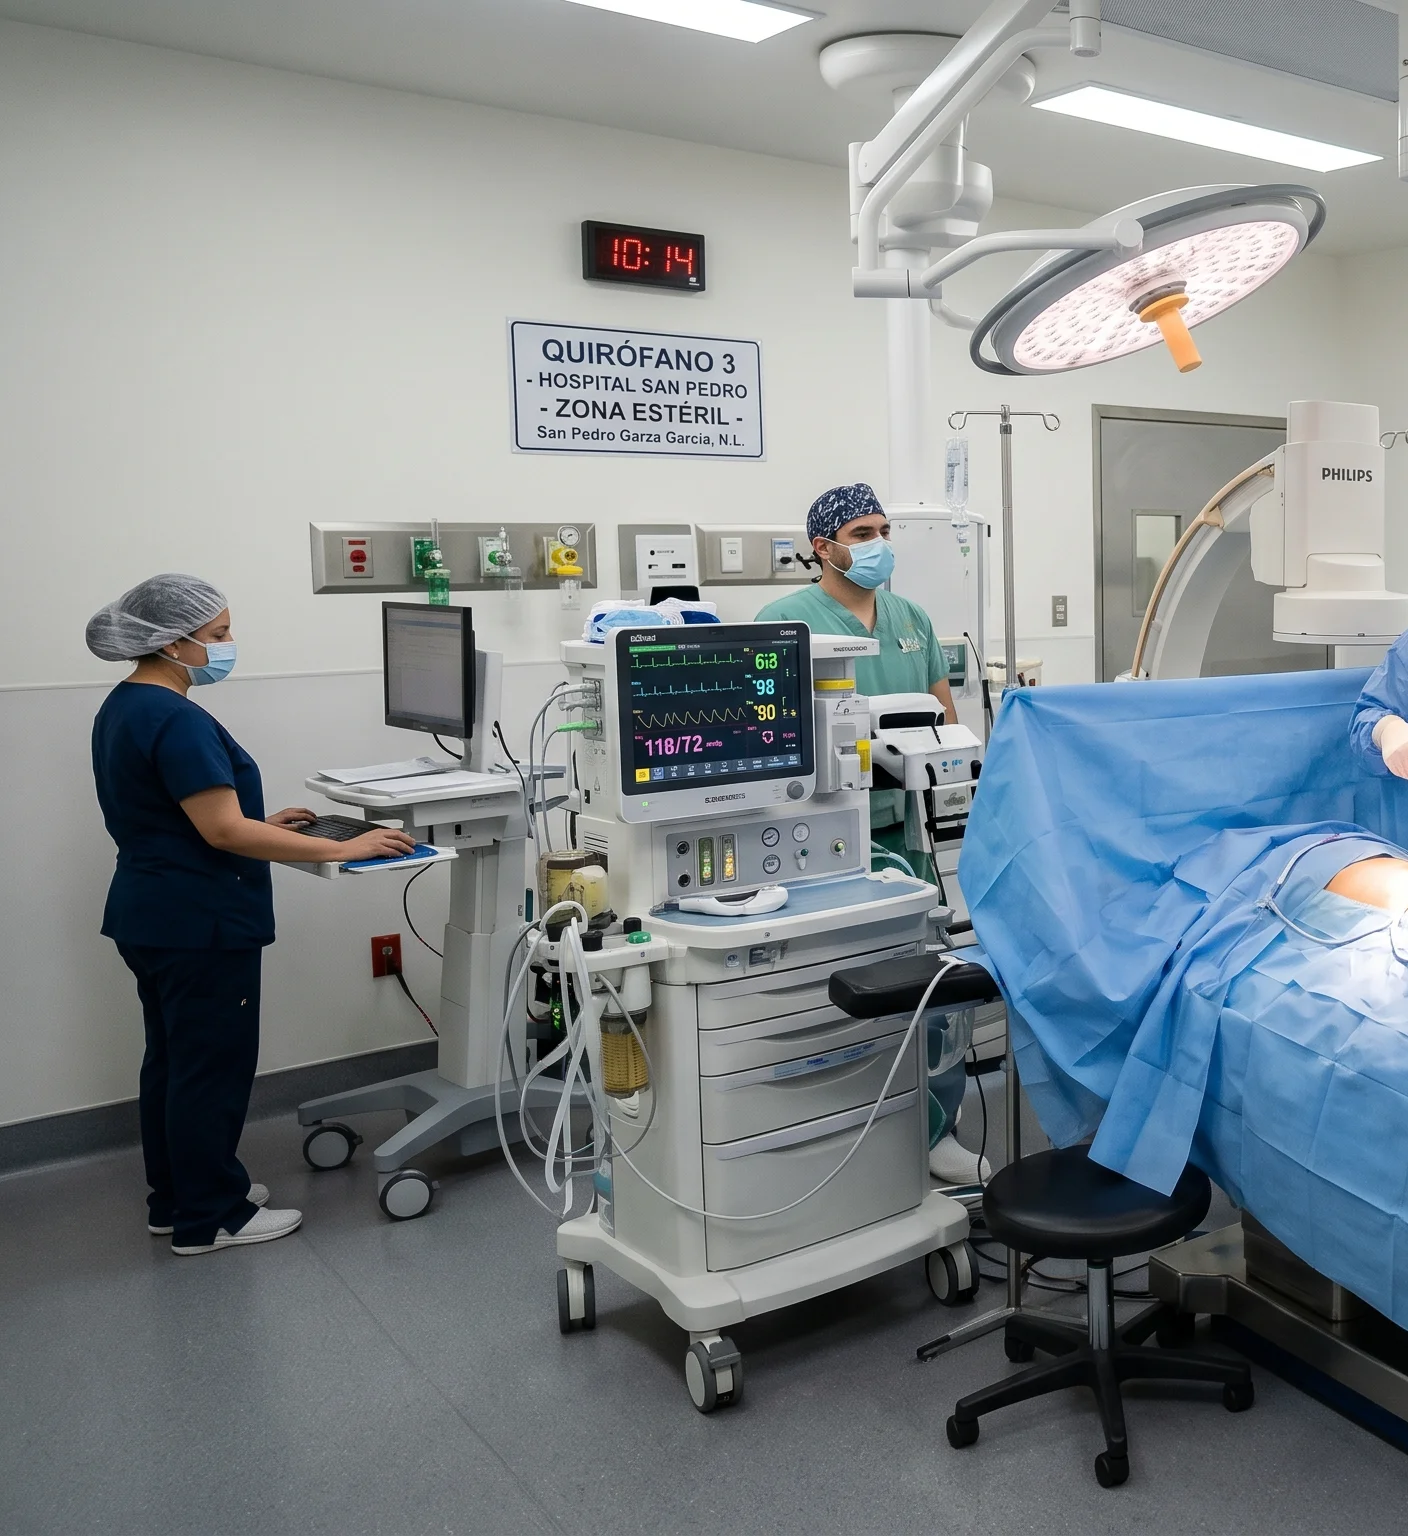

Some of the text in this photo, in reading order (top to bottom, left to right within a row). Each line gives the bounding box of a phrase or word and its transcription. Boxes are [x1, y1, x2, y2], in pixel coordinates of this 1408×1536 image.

[613, 238, 693, 275] 10:14
[542, 338, 736, 375] QUIRÓFANO 3
[539, 371, 637, 393] HOSPITAL
[642, 378, 680, 395] SAN
[686, 381, 748, 399] PEDRO
[555, 398, 626, 421] ZONA
[632, 400, 730, 426] ESTÉRIL
[537, 425, 566, 439] San
[571, 427, 616, 441] Pedro
[619, 429, 661, 443] Garza
[719, 433, 745, 447] N.L.
[1321, 467, 1373, 482] PHILIPS
[644, 734, 703, 757] 118/72
